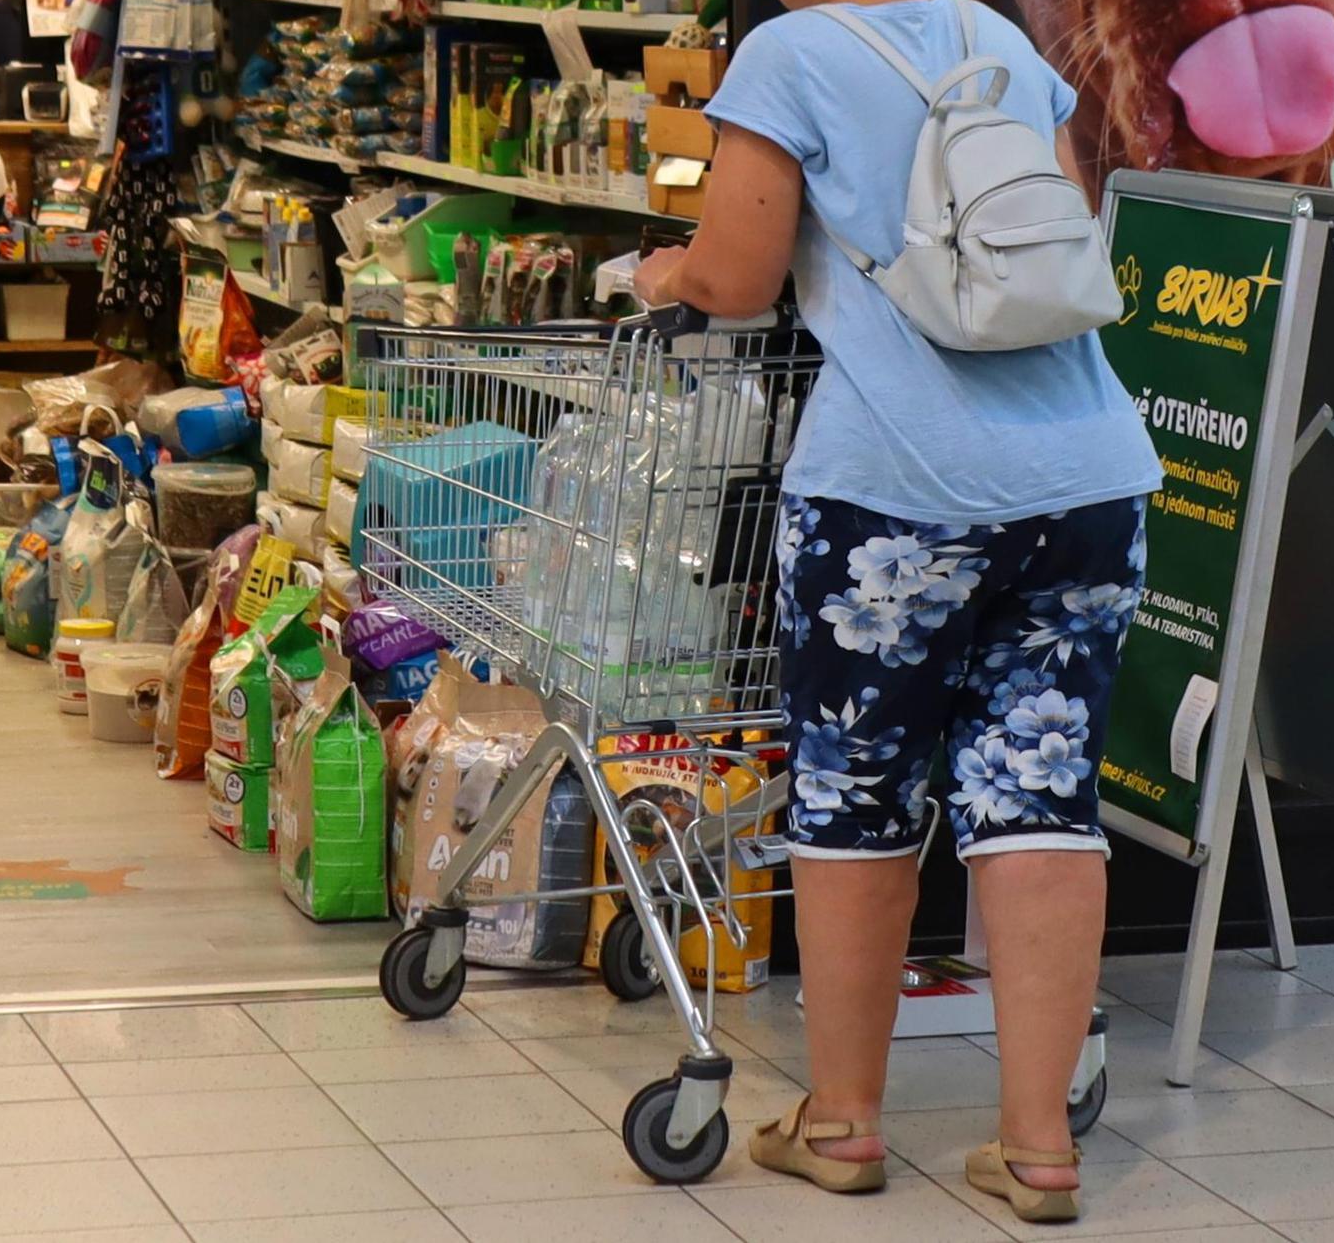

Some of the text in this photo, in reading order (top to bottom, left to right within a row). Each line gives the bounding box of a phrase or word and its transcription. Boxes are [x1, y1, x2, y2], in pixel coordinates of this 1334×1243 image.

[1157, 265, 1250, 327] SIRIUS
[1152, 395, 1248, 451] OTEVŘENO
[1196, 465, 1240, 500] mazlíčky
[1152, 491, 1236, 531] na jednom místě
